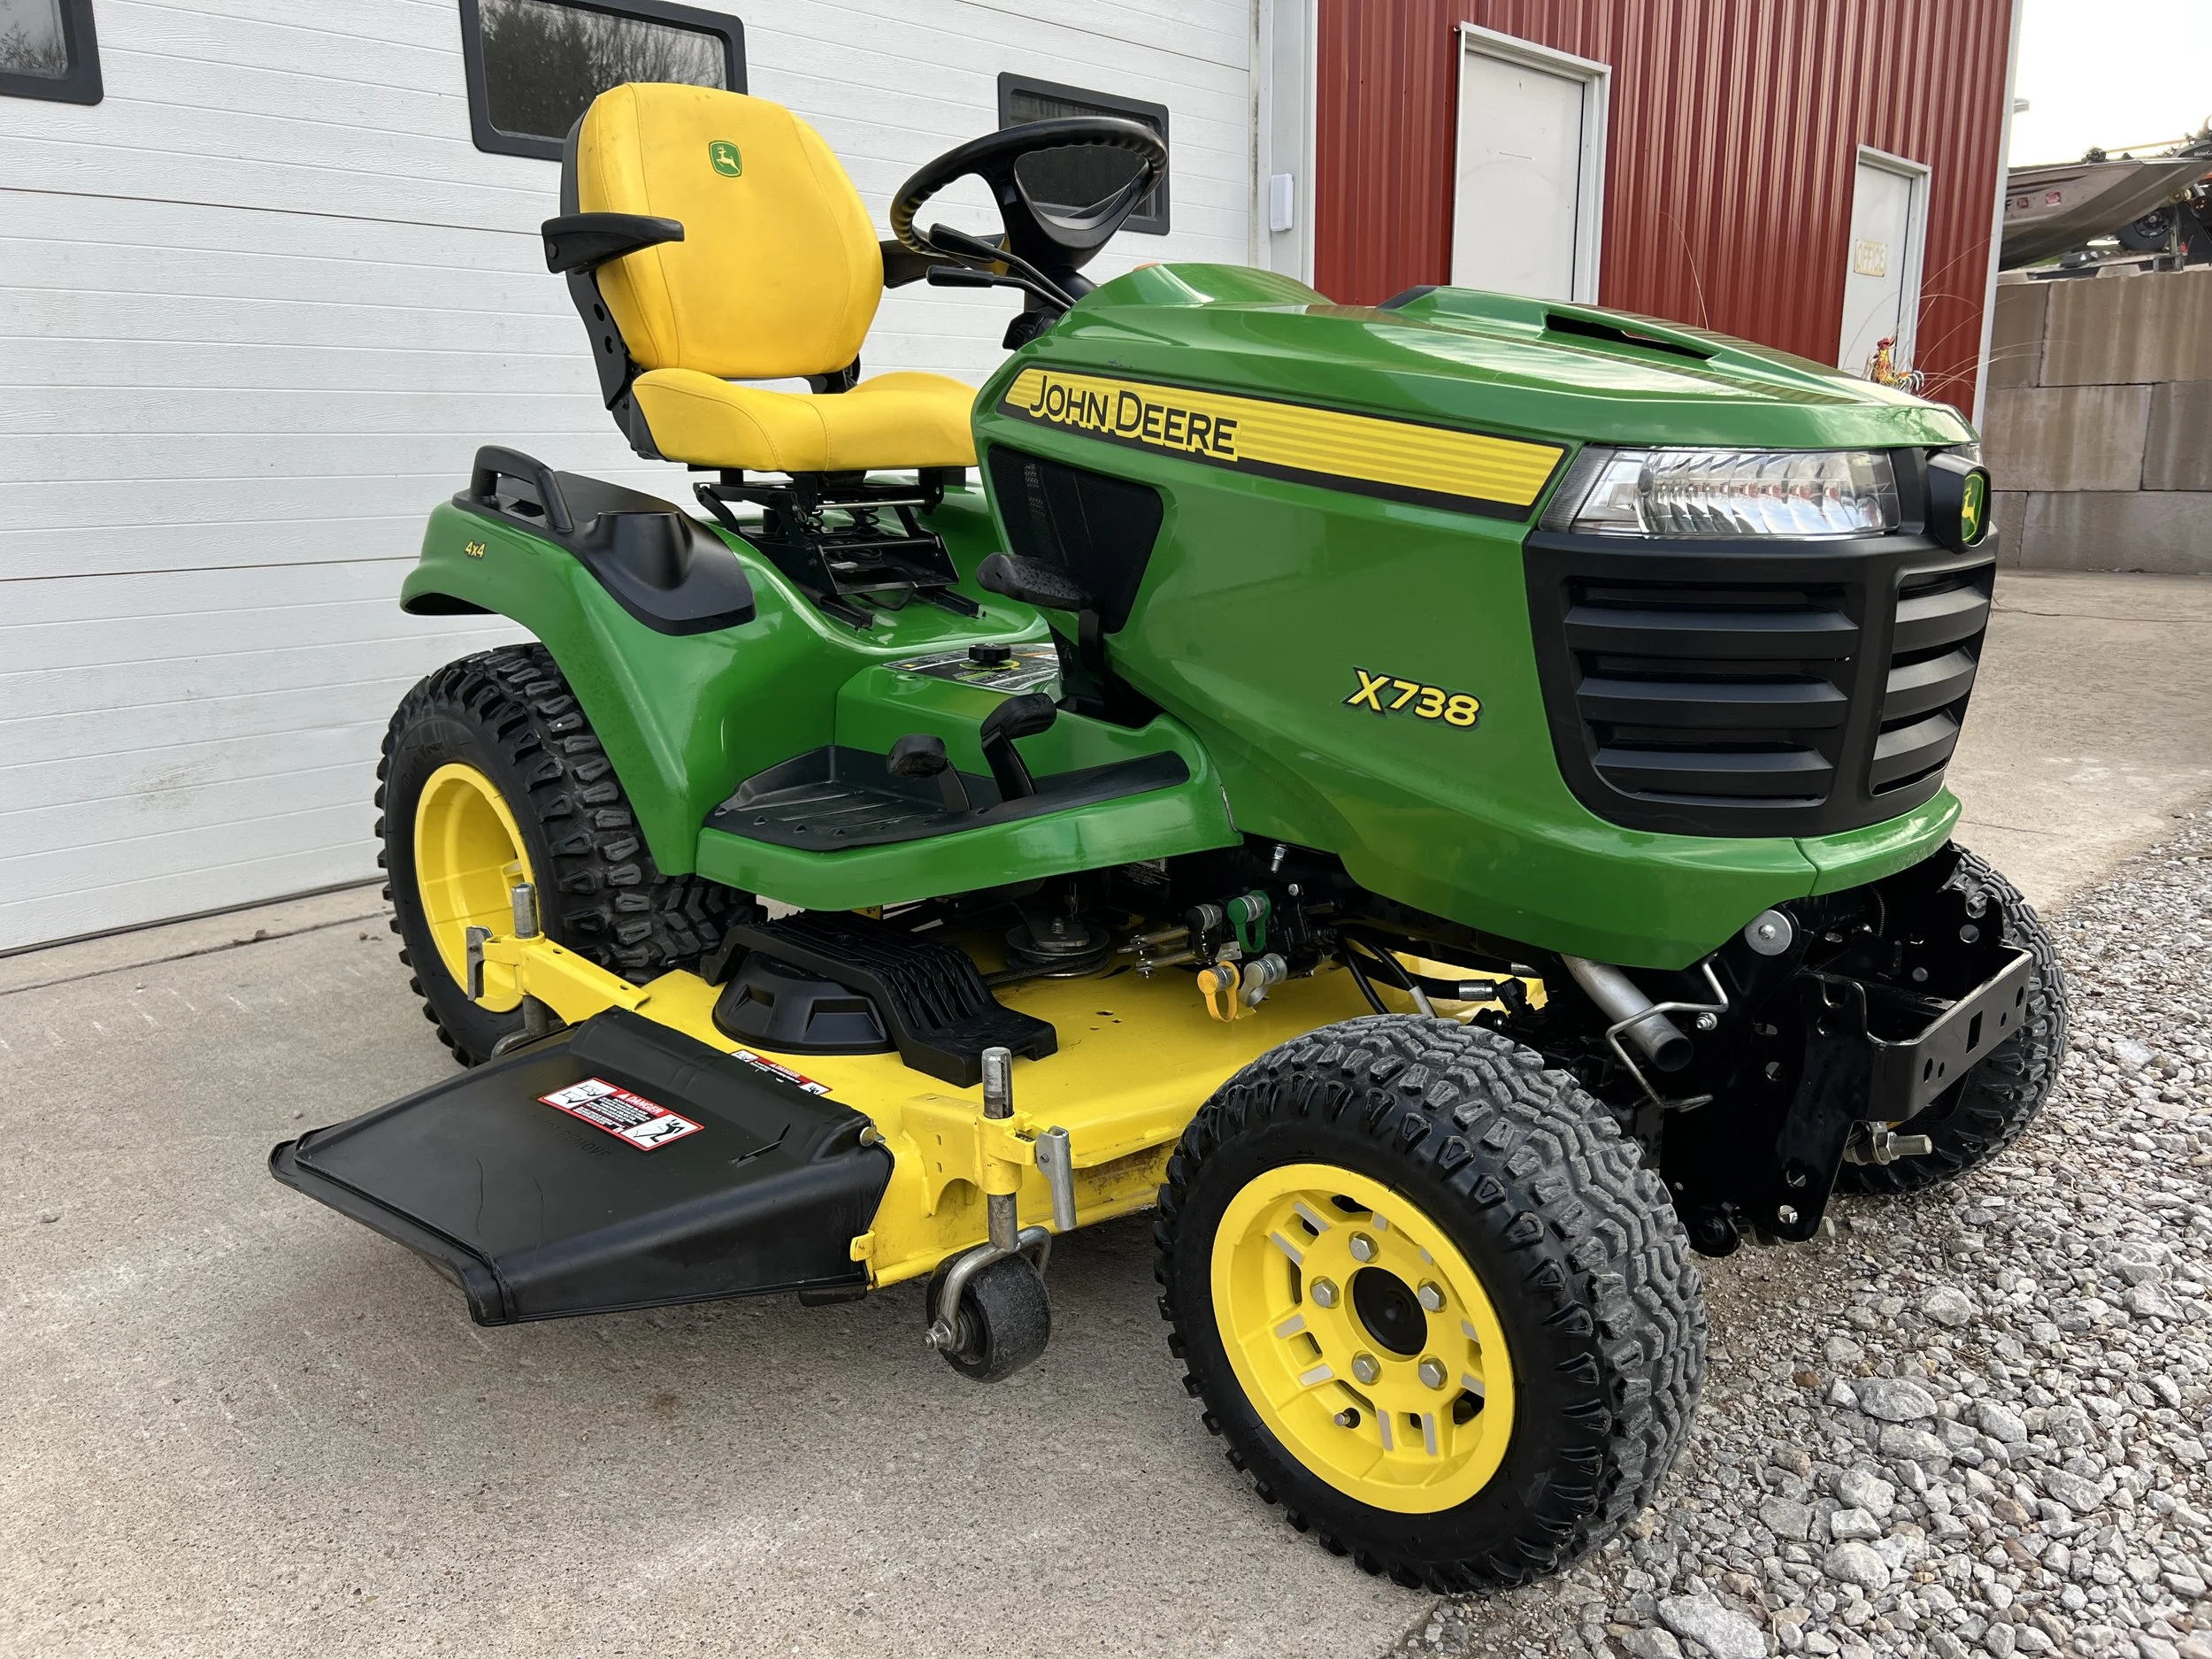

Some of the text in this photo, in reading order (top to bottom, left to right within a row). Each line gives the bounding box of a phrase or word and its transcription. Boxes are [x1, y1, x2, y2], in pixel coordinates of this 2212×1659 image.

[1029, 375, 1238, 457] JOHN DEERE
[465, 540, 486, 558] 4x4
[1344, 668, 1481, 727] X738
[626, 1094, 664, 1115] DANGER
